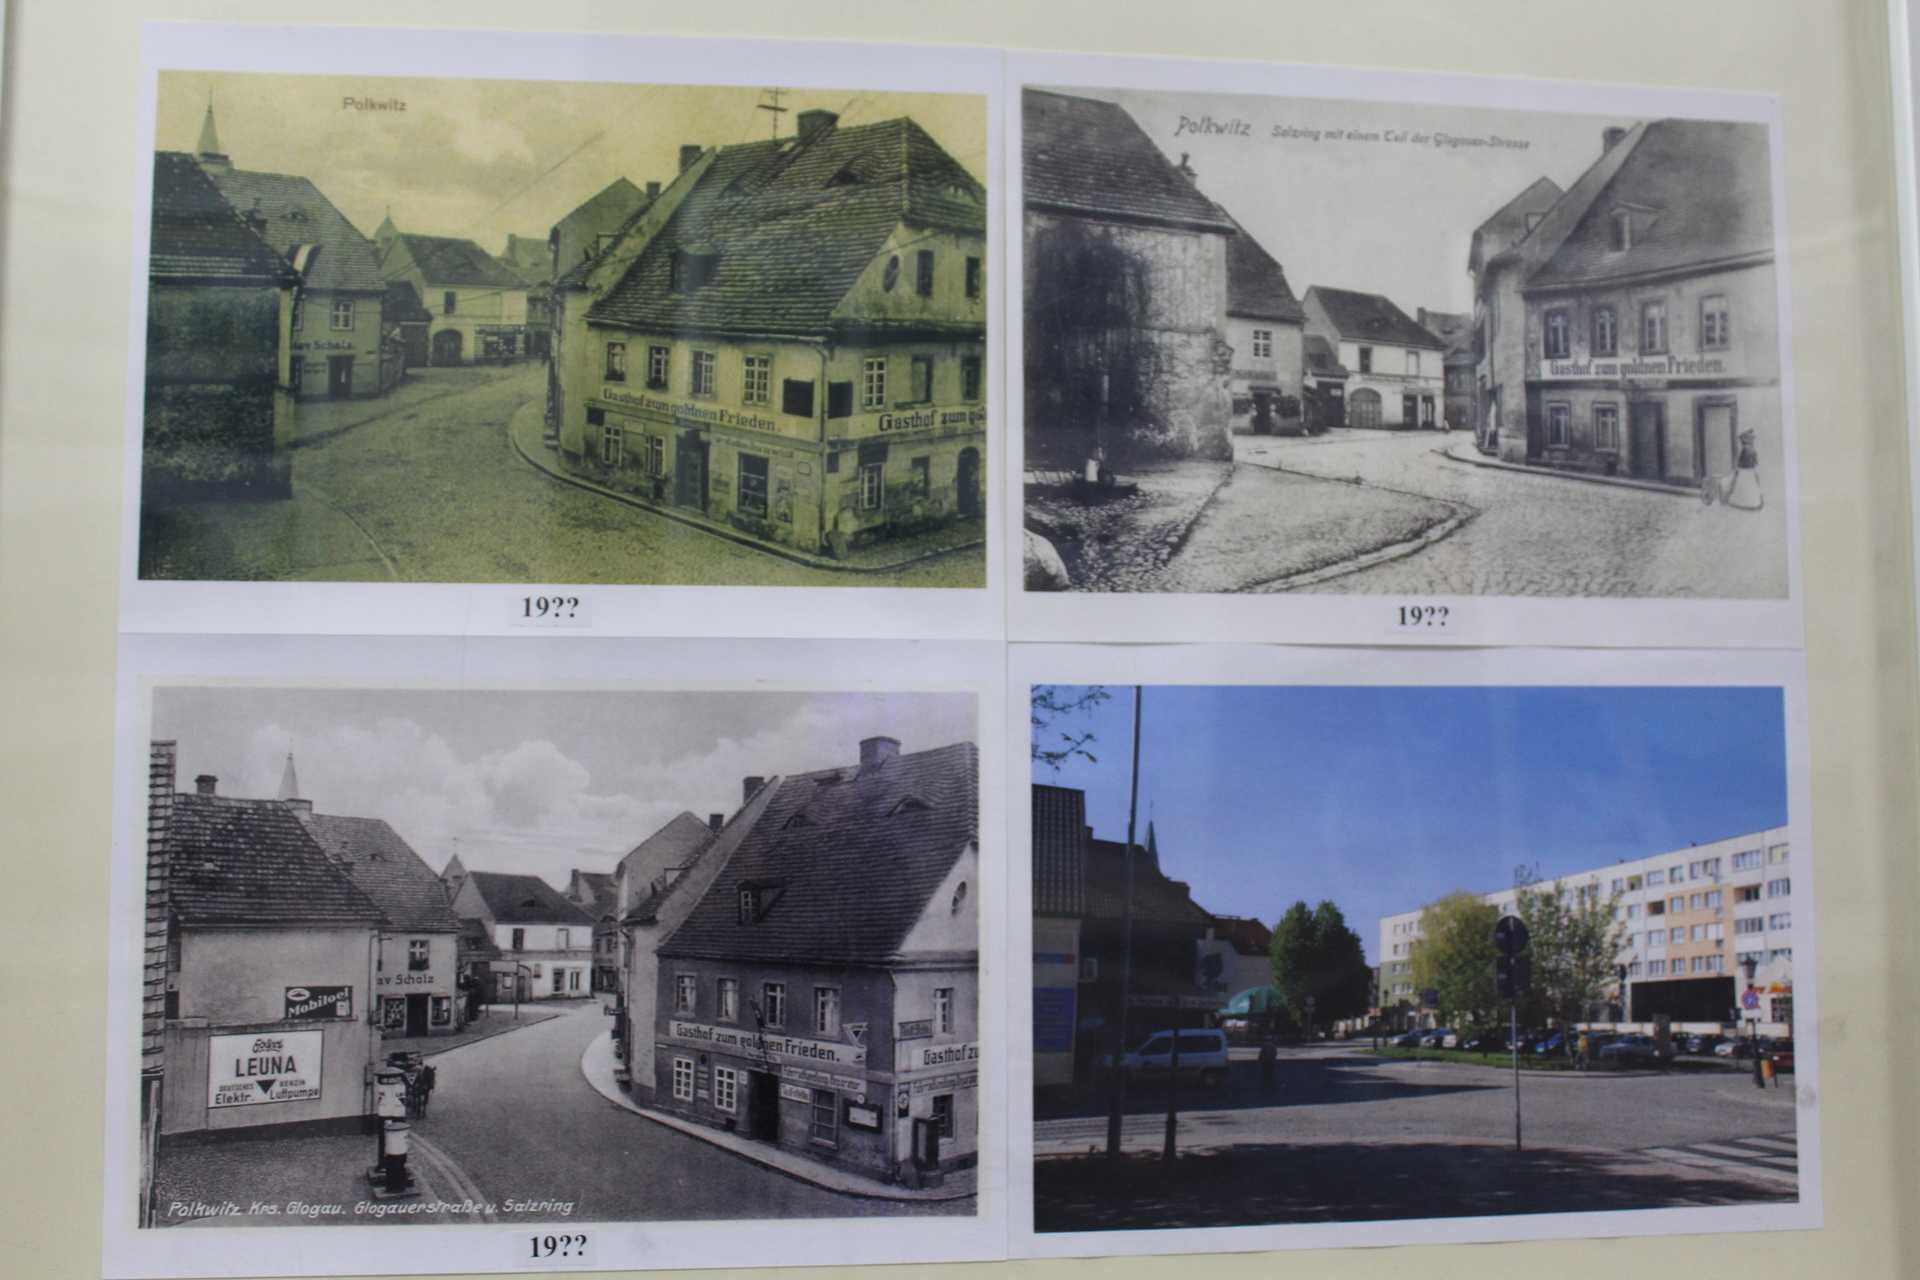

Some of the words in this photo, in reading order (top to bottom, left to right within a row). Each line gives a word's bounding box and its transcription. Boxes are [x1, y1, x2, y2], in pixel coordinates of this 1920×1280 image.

[343, 96, 407, 111] Polkwitz
[1174, 115, 1251, 137] Polkwitz
[1272, 125, 1321, 141] Salzring
[1324, 128, 1345, 139] mit
[1346, 129, 1380, 141] einem
[1384, 129, 1408, 142] Teil
[1411, 131, 1430, 143] der
[1551, 359, 1593, 376] Gasthof
[1595, 362, 1618, 375] zum
[1620, 356, 1666, 378] goldnen
[1668, 355, 1728, 374] Frieden.
[604, 387, 645, 406] Gasthof
[645, 399, 669, 412] zum
[719, 408, 782, 432] Frieden.
[879, 408, 937, 432] Gasthof
[941, 411, 967, 425] zum
[522, 596, 579, 618] 19??
[1399, 605, 1449, 627] 19??
[395, 974, 434, 985] Scholz
[287, 987, 350, 1018] Mobiloel
[677, 1023, 713, 1041] Gasthof
[716, 1032, 737, 1046] zum
[740, 1033, 783, 1052] golnen
[785, 1038, 840, 1062] Frieden.
[924, 1043, 967, 1066] Gasthof
[235, 1055, 297, 1077] LEUNA
[215, 1093, 254, 1105] Elektr.
[270, 1088, 319, 1100] Luftpumpe
[219, 1083, 254, 1092] DEUTSCHES
[167, 1201, 242, 1217] Polkwitz
[248, 1201, 281, 1215] Krs.
[286, 1202, 346, 1218] Glogau.
[354, 1200, 483, 1218] Glogauerstraße
[485, 1203, 498, 1215] u.
[503, 1199, 574, 1216] Salzring
[530, 1234, 587, 1258] 19??
